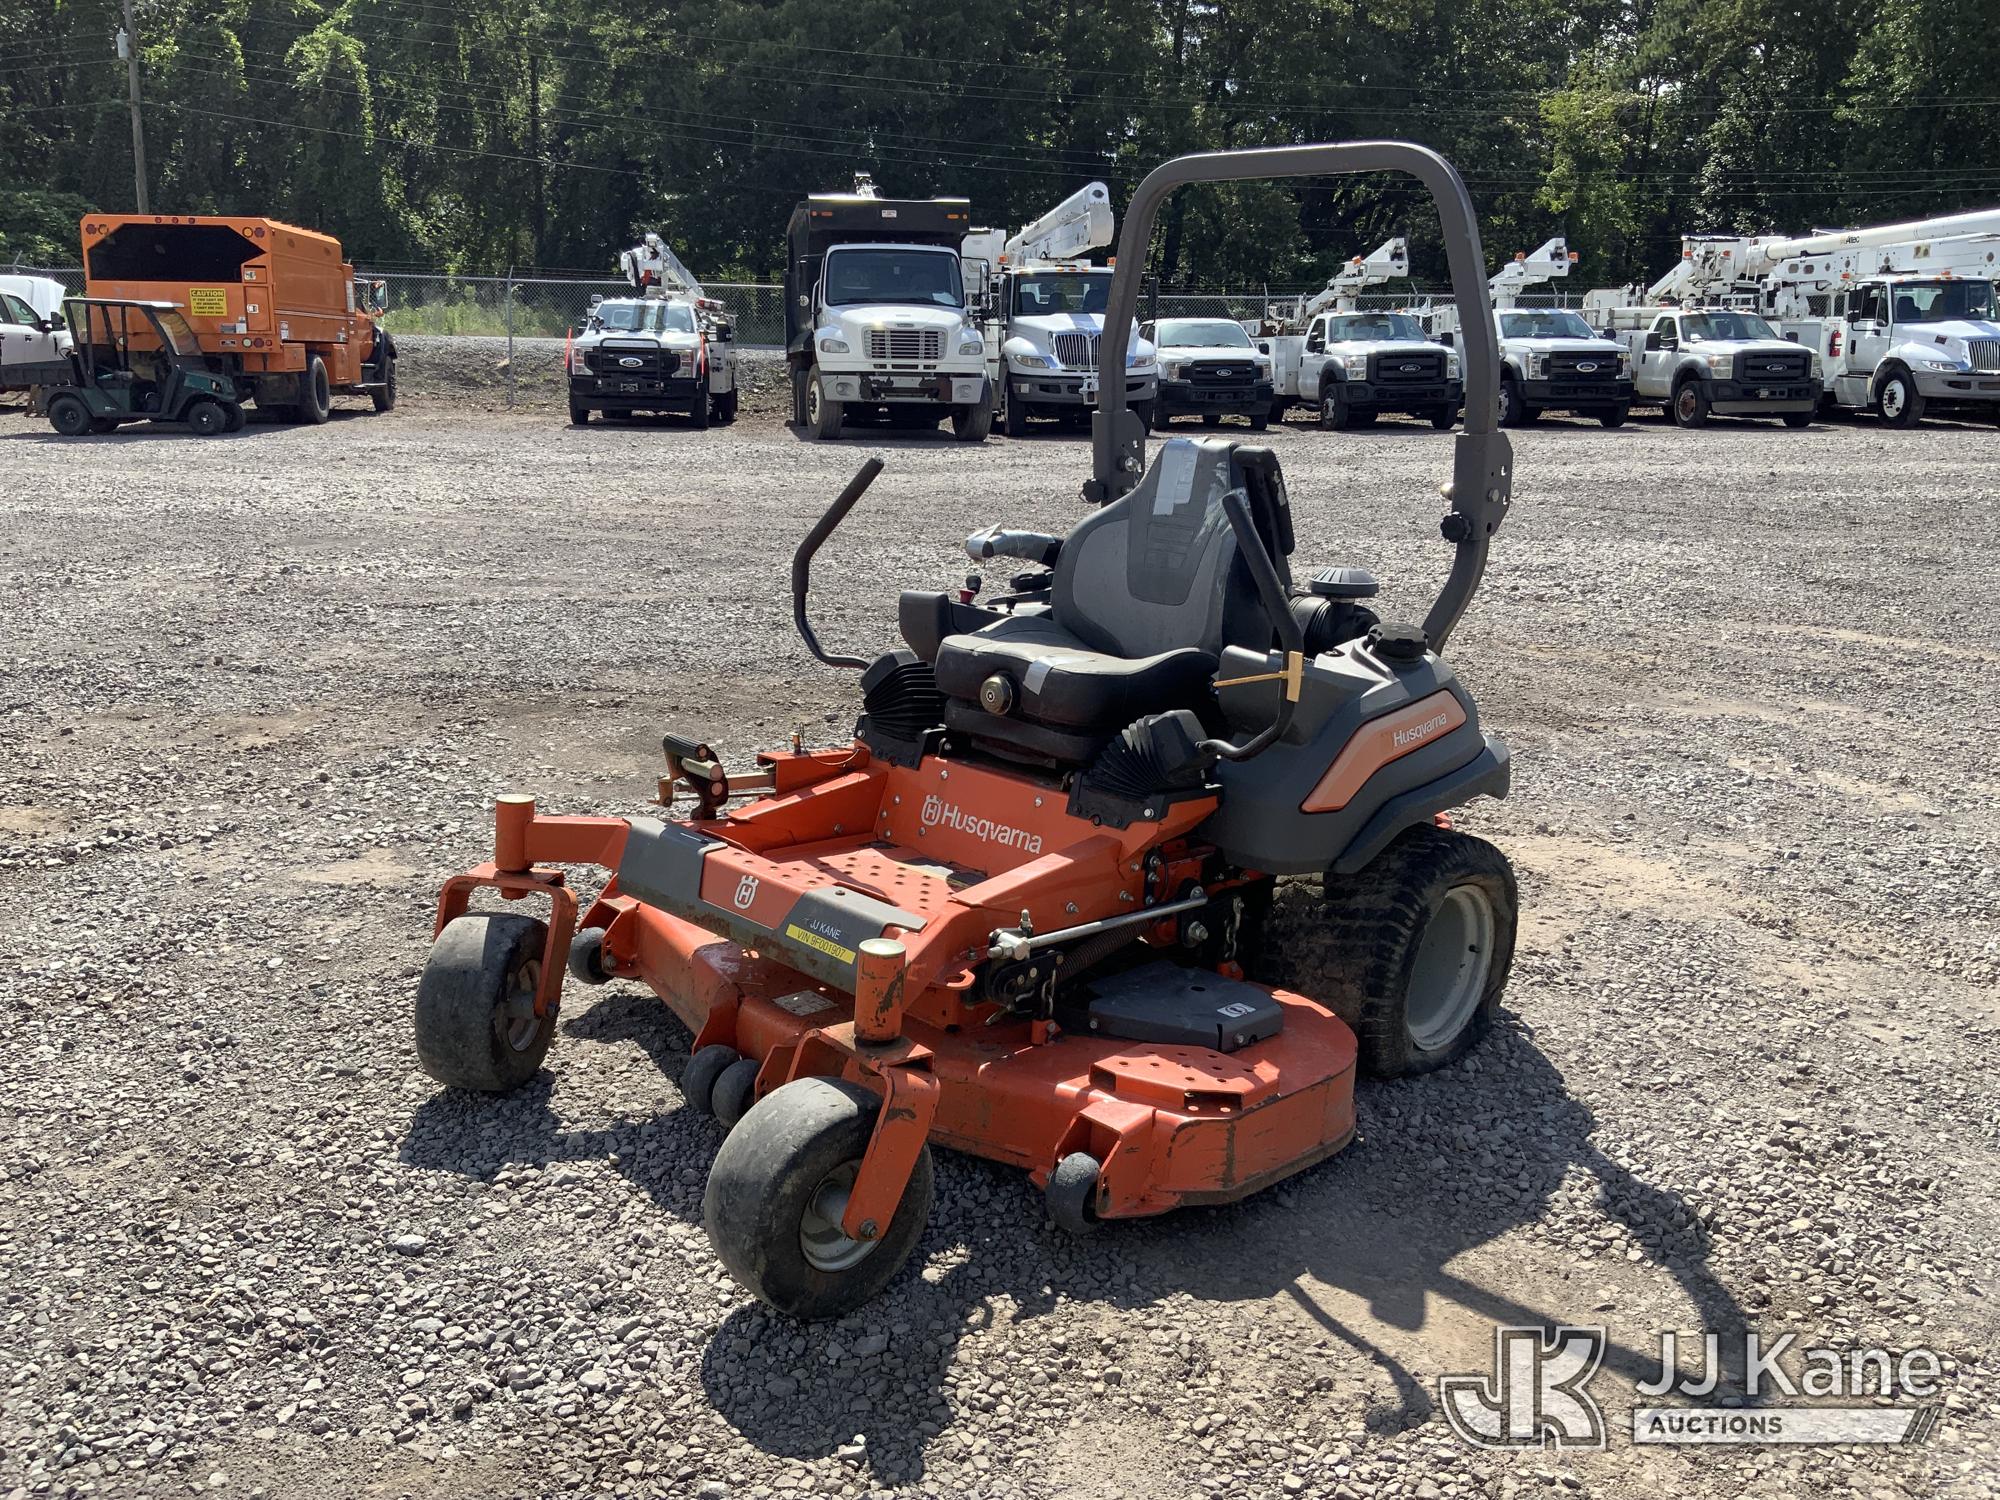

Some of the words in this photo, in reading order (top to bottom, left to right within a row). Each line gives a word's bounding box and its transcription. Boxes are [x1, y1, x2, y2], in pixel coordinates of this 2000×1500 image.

[1393, 713, 1447, 747] Husqvarna
[941, 803, 1042, 854] Husqvarna
[797, 930, 810, 942] VIN
[810, 935, 846, 958] 9F001907
[810, 919, 820, 930] JJ
[819, 922, 841, 940] KANE
